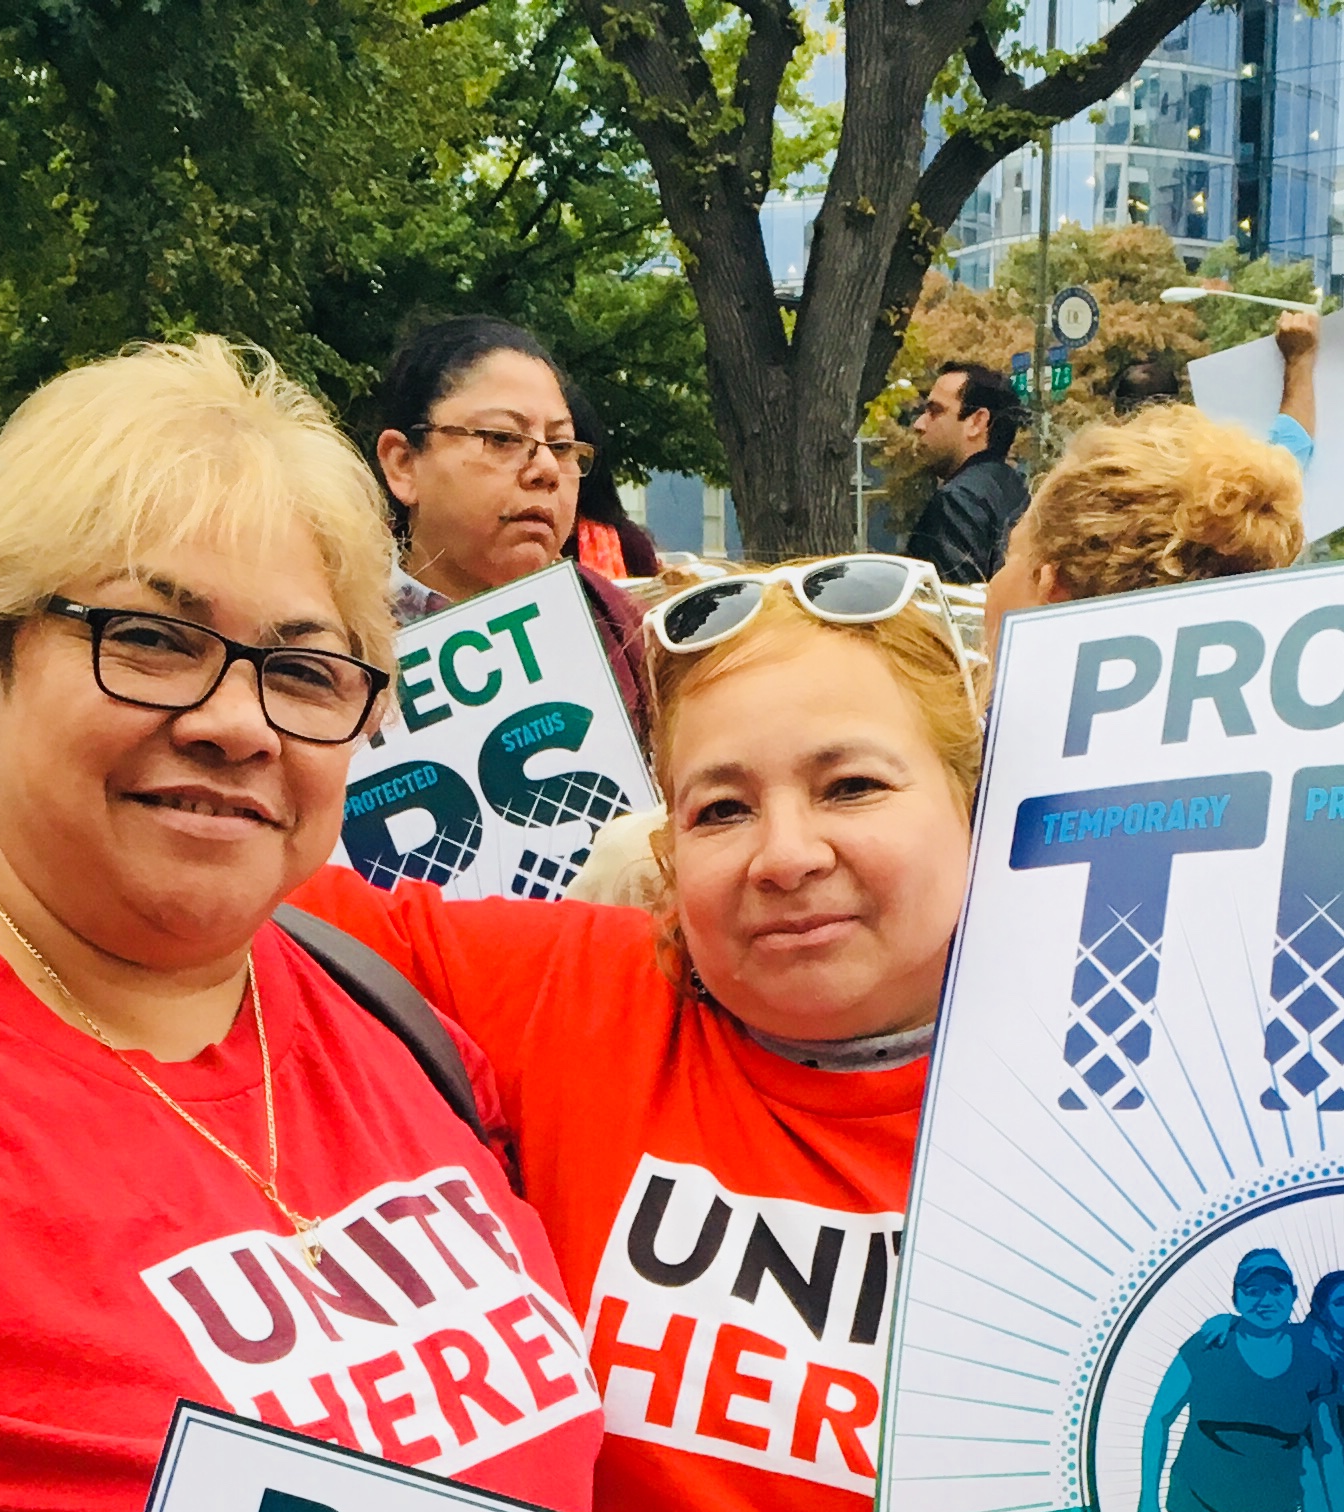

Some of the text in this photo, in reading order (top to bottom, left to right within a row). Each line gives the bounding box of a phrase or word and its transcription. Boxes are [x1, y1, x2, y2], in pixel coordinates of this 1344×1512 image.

[369, 602, 545, 750] ECT
[501, 711, 566, 753] STATUS
[344, 765, 439, 821] PROTECTED
[1041, 793, 1231, 846] TEMPORARY
[167, 1179, 522, 1365] UNITE
[626, 1174, 903, 1346] UNI
[589, 1294, 881, 1479] HER
